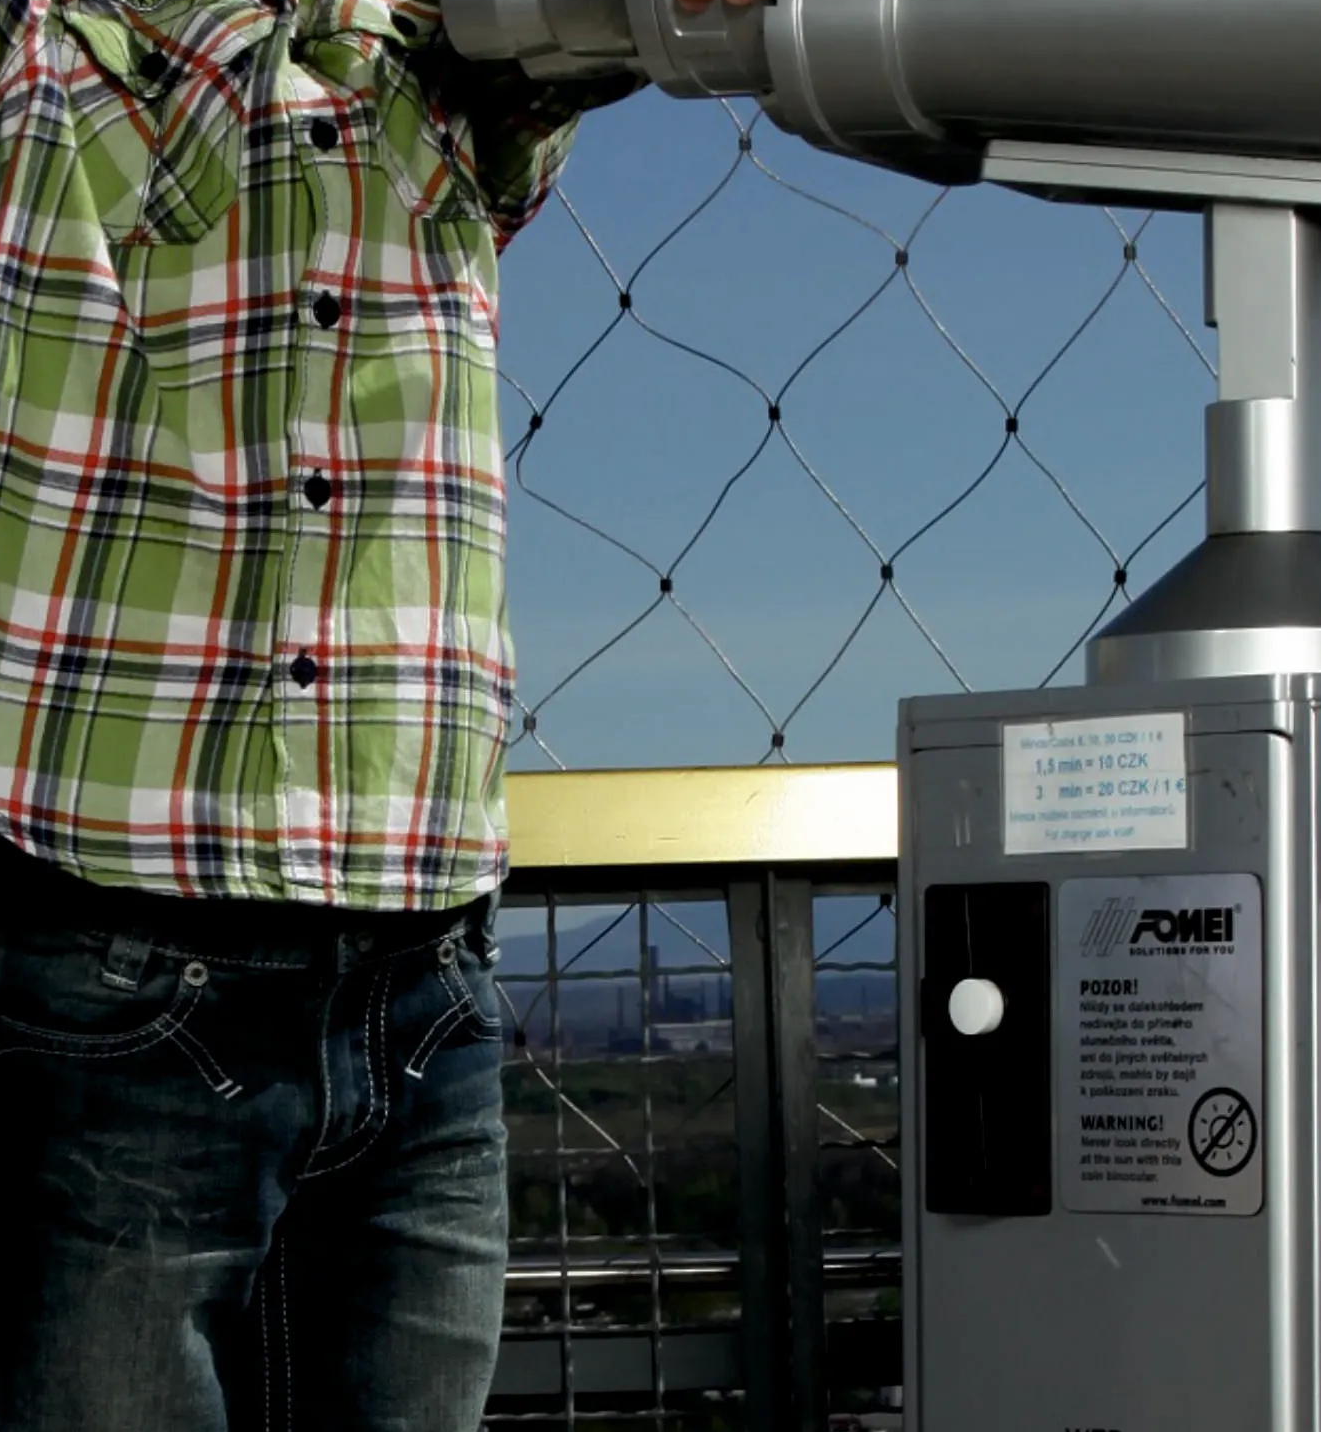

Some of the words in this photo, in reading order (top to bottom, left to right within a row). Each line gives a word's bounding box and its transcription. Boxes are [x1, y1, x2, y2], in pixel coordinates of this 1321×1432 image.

[1036, 757, 1055, 776] 1,5
[1058, 756, 1083, 773] min
[1098, 756, 1114, 770] 10
[1117, 753, 1149, 768] CZK
[1036, 785, 1043, 800] 3
[1059, 783, 1083, 799] min
[1098, 781, 1114, 796] 20
[1118, 780, 1149, 795] CZK
[1164, 779, 1169, 794] 1
[1129, 908, 1234, 944] FOMEI
[1129, 947, 1186, 957] SOLUTIONS
[1189, 946, 1210, 955] FOR
[1213, 945, 1235, 955] YOU
[1080, 978, 1138, 996] POZOR!
[1080, 1114, 1164, 1132] WARNING!
[1081, 1136, 1111, 1148] Never
[1113, 1136, 1138, 1148] look
[1140, 1136, 1182, 1151] directly
[1080, 1153, 1092, 1165] at
[1094, 1153, 1111, 1165] the
[1114, 1155, 1133, 1165] sun
[1136, 1154, 1159, 1166] with
[1140, 1192, 1227, 1208] www.fomei.com
